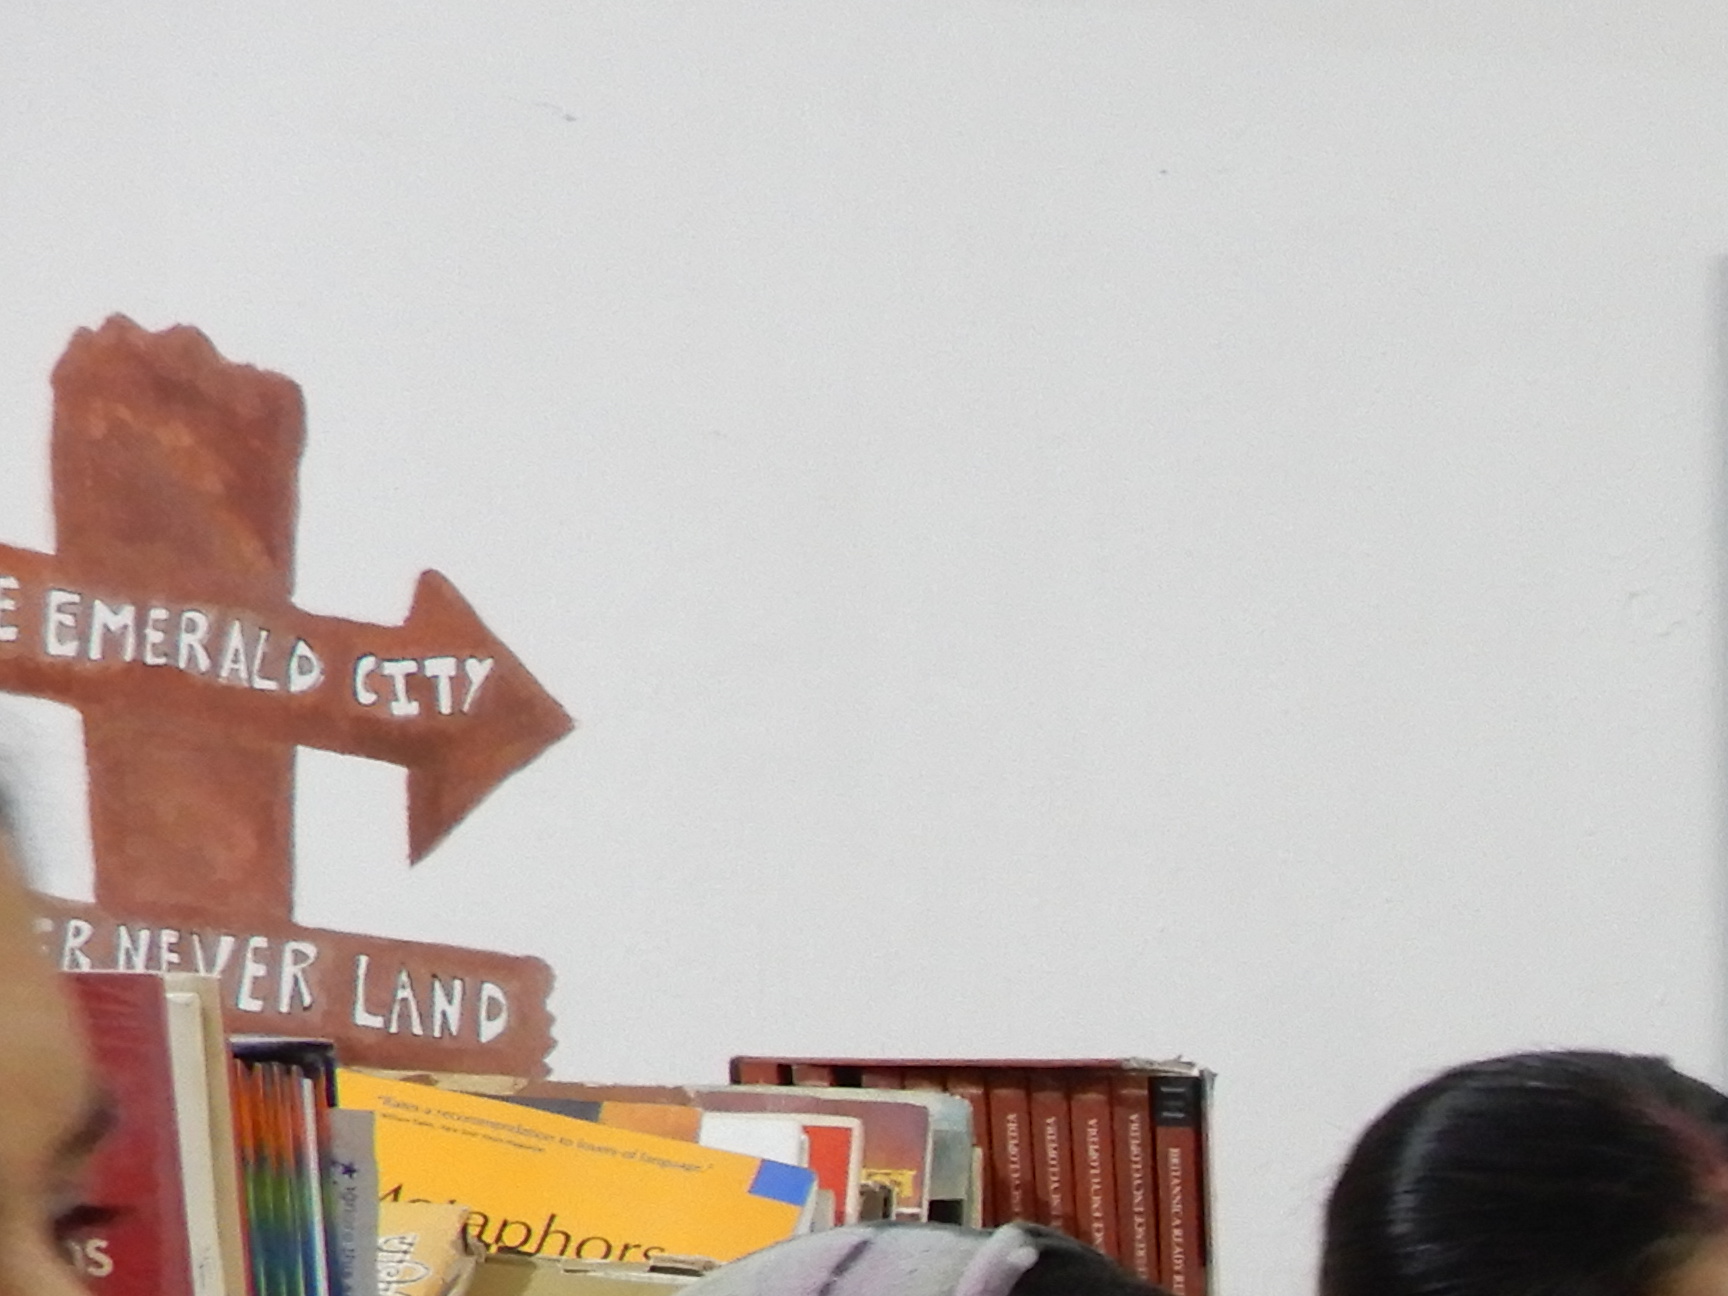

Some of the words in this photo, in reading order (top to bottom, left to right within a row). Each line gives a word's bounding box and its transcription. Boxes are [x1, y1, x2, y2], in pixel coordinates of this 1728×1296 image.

[45, 589, 325, 693] EMERALD
[353, 655, 496, 717] CITY
[116, 923, 319, 1013] NEVER
[353, 955, 509, 1044] LAND
[381, 1184, 666, 1263] aphors
[1166, 1147, 1182, 1227] BRITANNICA
